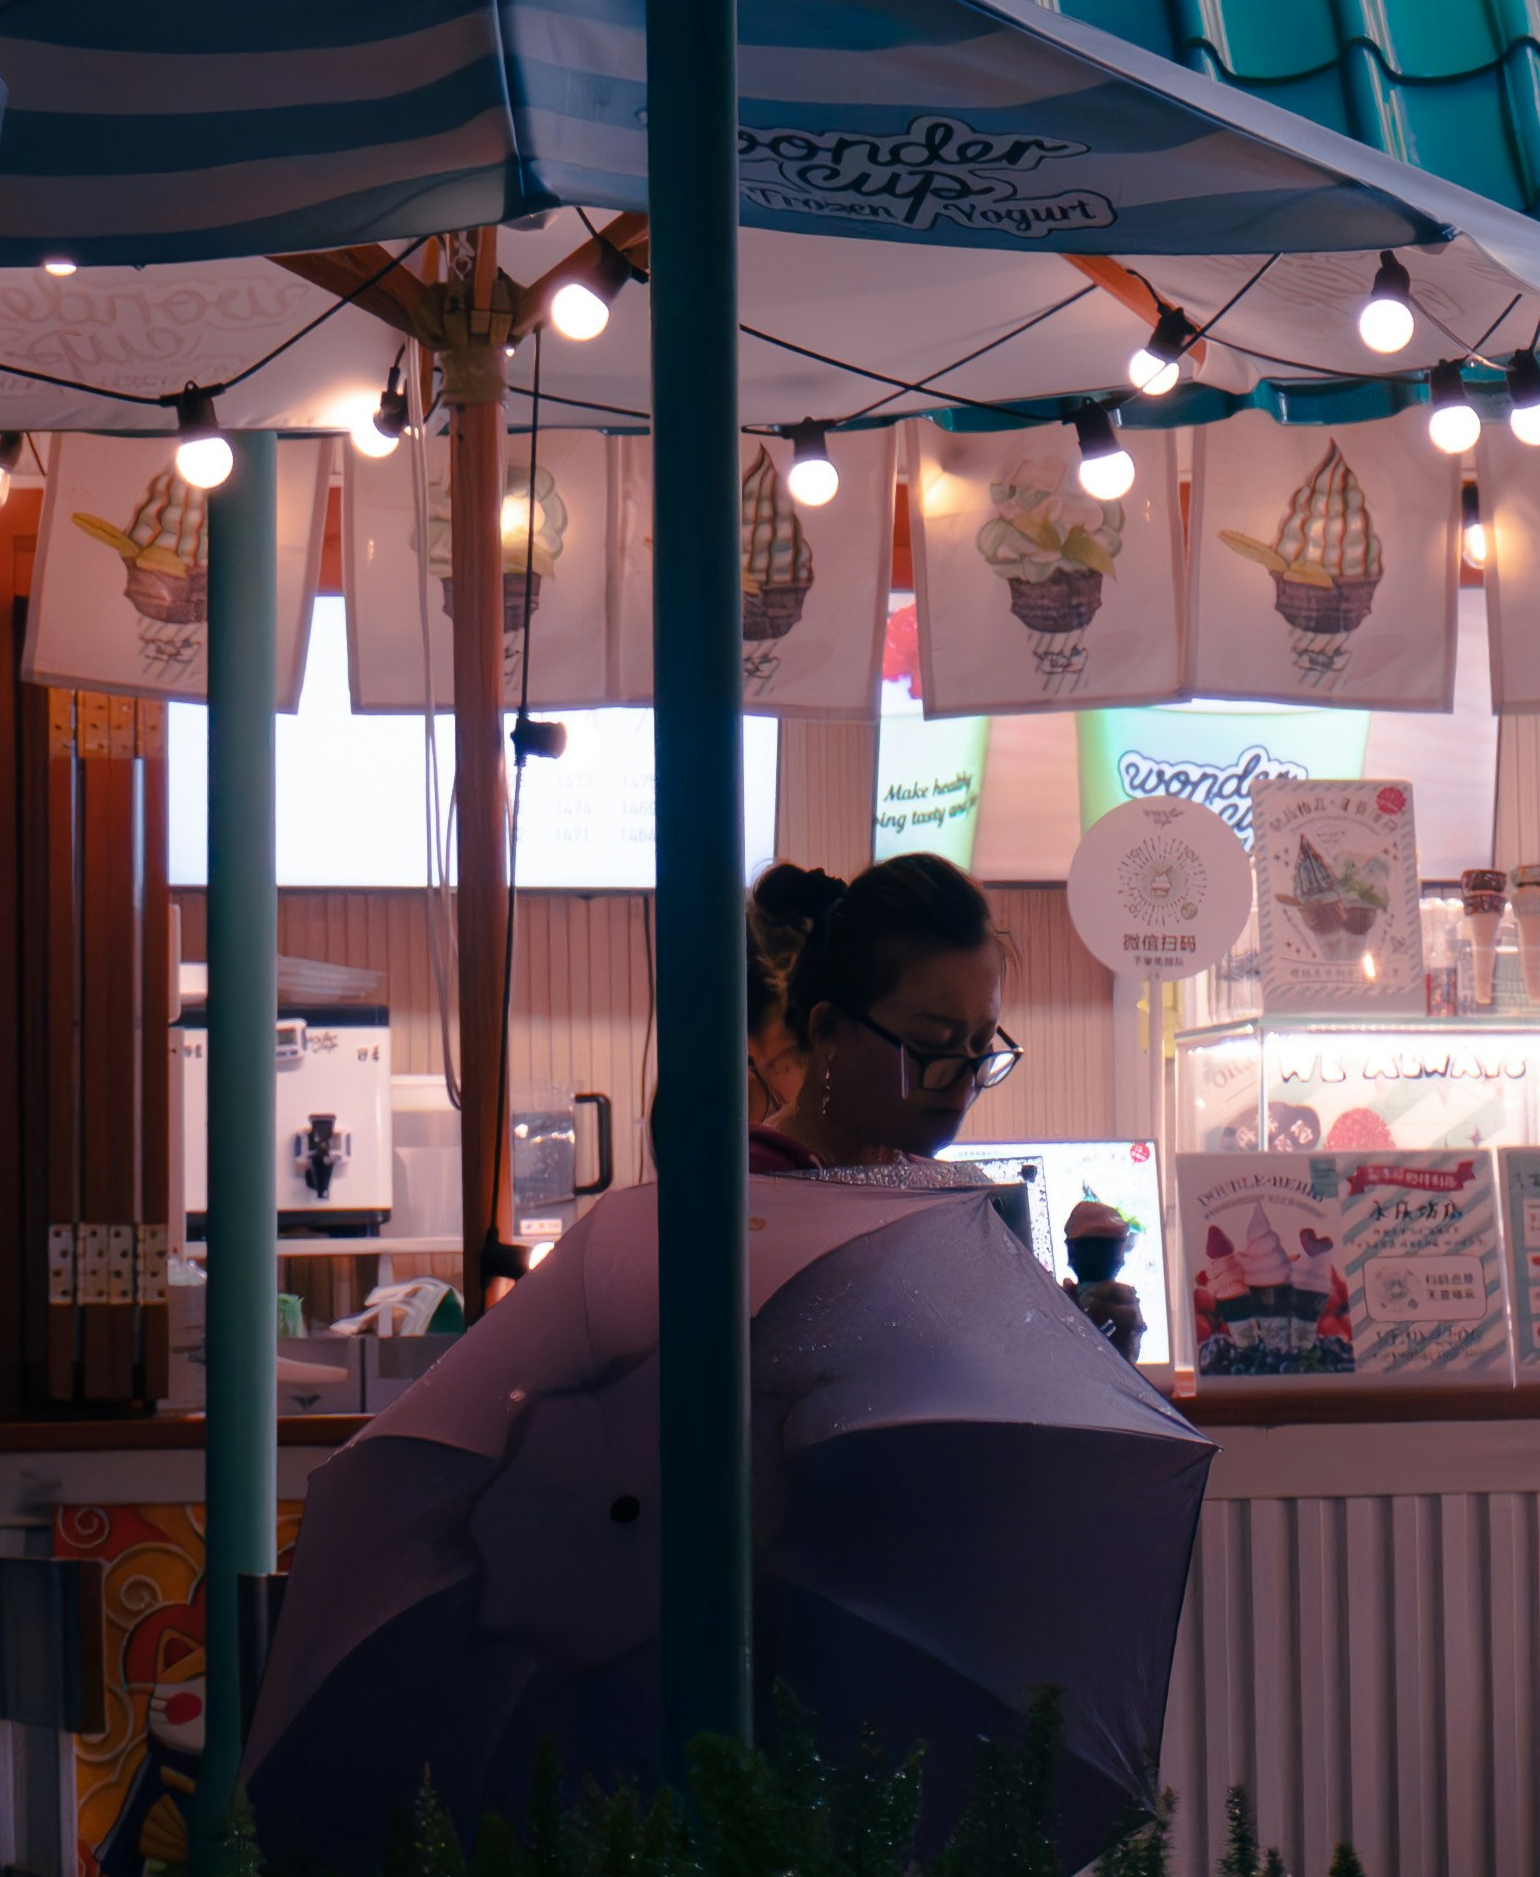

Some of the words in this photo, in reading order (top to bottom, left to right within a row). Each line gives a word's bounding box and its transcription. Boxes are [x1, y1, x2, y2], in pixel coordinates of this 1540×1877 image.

[798, 164, 995, 224] cup
[942, 197, 1097, 231] Yogurt
[883, 780, 930, 803] Make
[1123, 933, 1197, 953] 微信扫码
